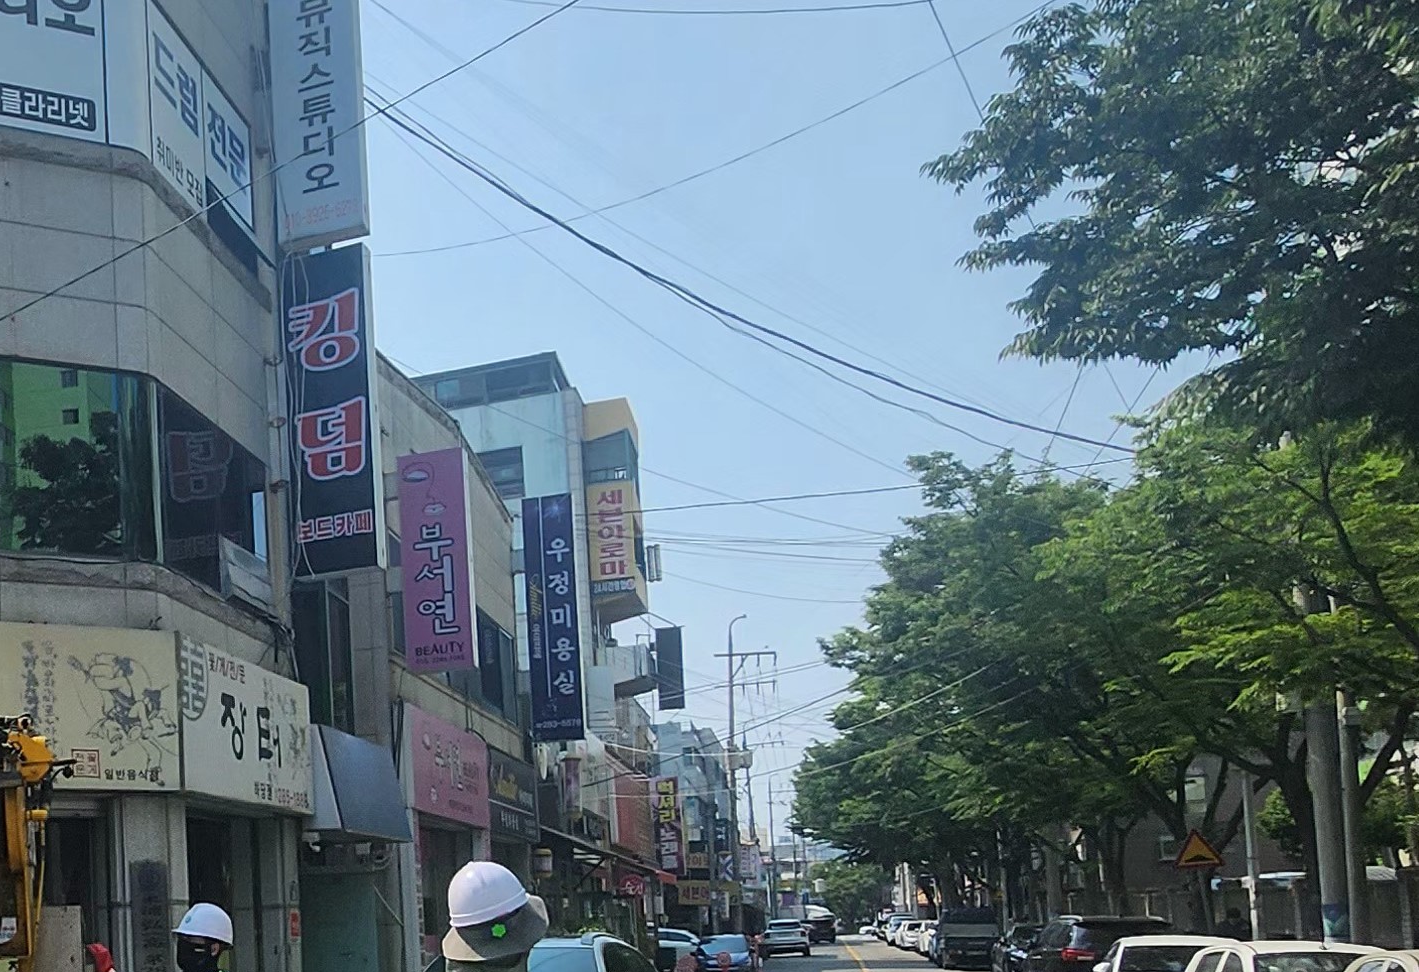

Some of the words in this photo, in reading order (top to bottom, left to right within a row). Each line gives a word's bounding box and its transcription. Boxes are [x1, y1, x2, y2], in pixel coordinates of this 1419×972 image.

[0, 86, 90, 127] 클라리넷
[412, 523, 461, 636] 부서연
[545, 537, 576, 696] 우정미용실
[414, 640, 465, 657] BEAUTY
